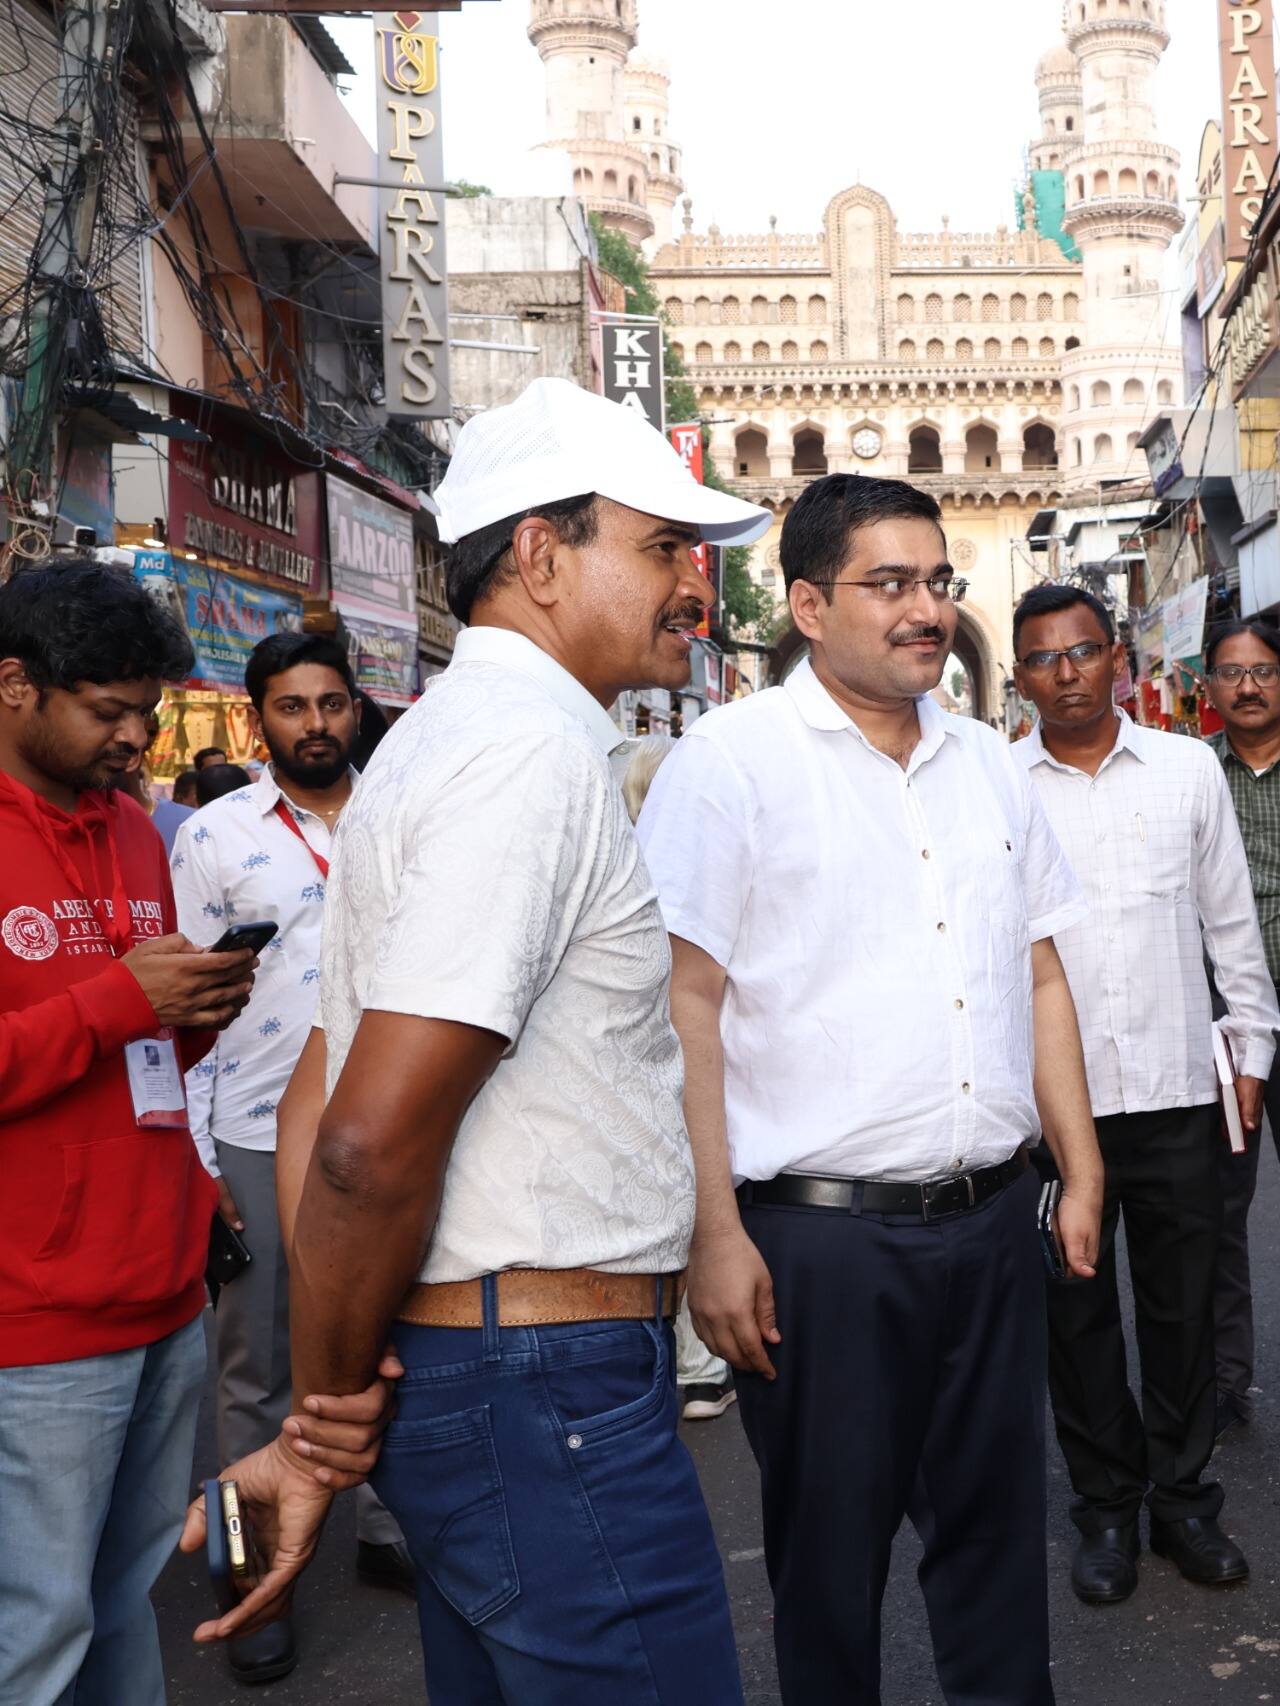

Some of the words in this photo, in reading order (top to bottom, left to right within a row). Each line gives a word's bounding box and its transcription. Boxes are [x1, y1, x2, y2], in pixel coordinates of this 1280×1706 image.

[1229, 10, 1278, 243] PARAS
[387, 101, 444, 406] PARAS
[613, 328, 651, 419] KHA
[139, 556, 165, 570] Md
[338, 515, 414, 588] AARZOO
